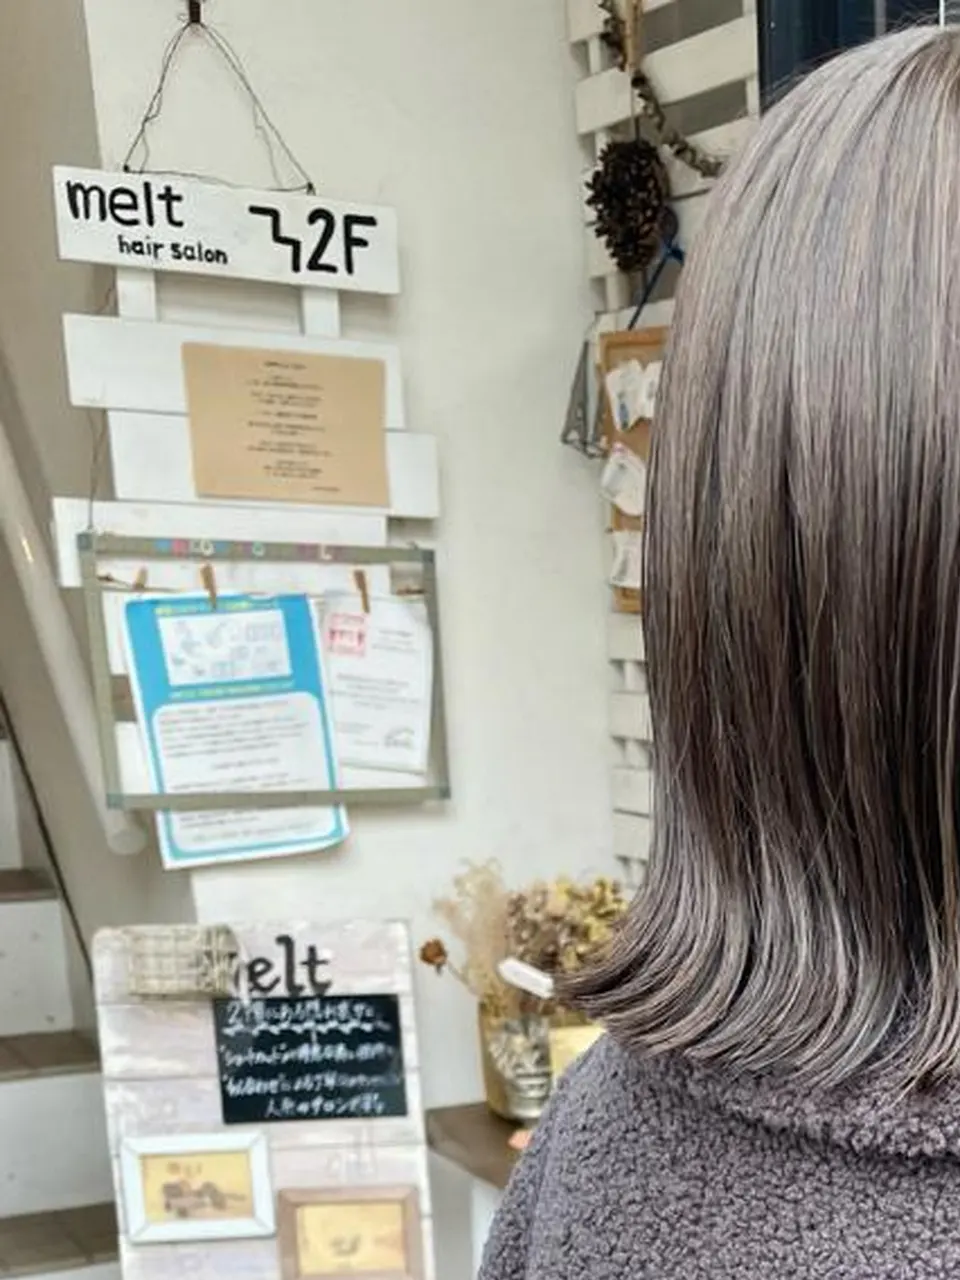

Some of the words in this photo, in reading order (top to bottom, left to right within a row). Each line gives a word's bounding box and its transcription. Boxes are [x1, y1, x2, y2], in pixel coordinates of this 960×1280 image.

[66, 180, 184, 228] melt
[117, 235, 164, 259] hair
[171, 239, 228, 265] salon
[306, 208, 378, 275] 2F
[232, 934, 333, 999] elt
